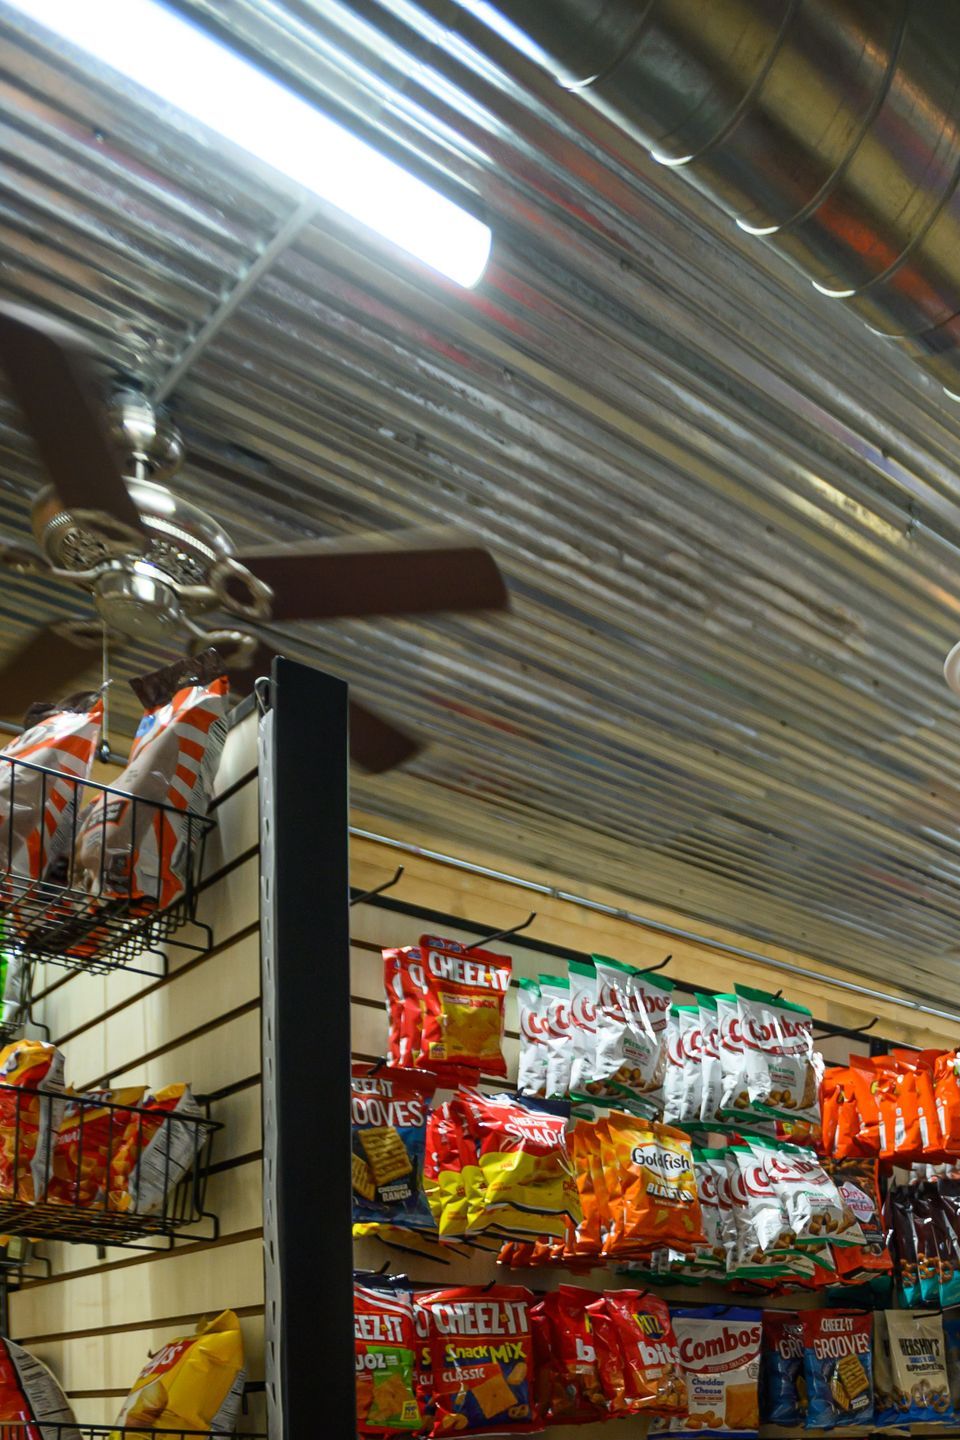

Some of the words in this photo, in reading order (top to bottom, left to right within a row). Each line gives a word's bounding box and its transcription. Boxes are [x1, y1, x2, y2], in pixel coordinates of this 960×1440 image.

[632, 1147, 691, 1172] Goldfish
[445, 1342, 488, 1362] Snack
[679, 1326, 761, 1363] Combos
[813, 1332, 871, 1360] GROOVES
[442, 1367, 486, 1383] CLASSIC
[691, 1377, 725, 1386] Cheddar
[694, 1386, 722, 1395] Cheese
